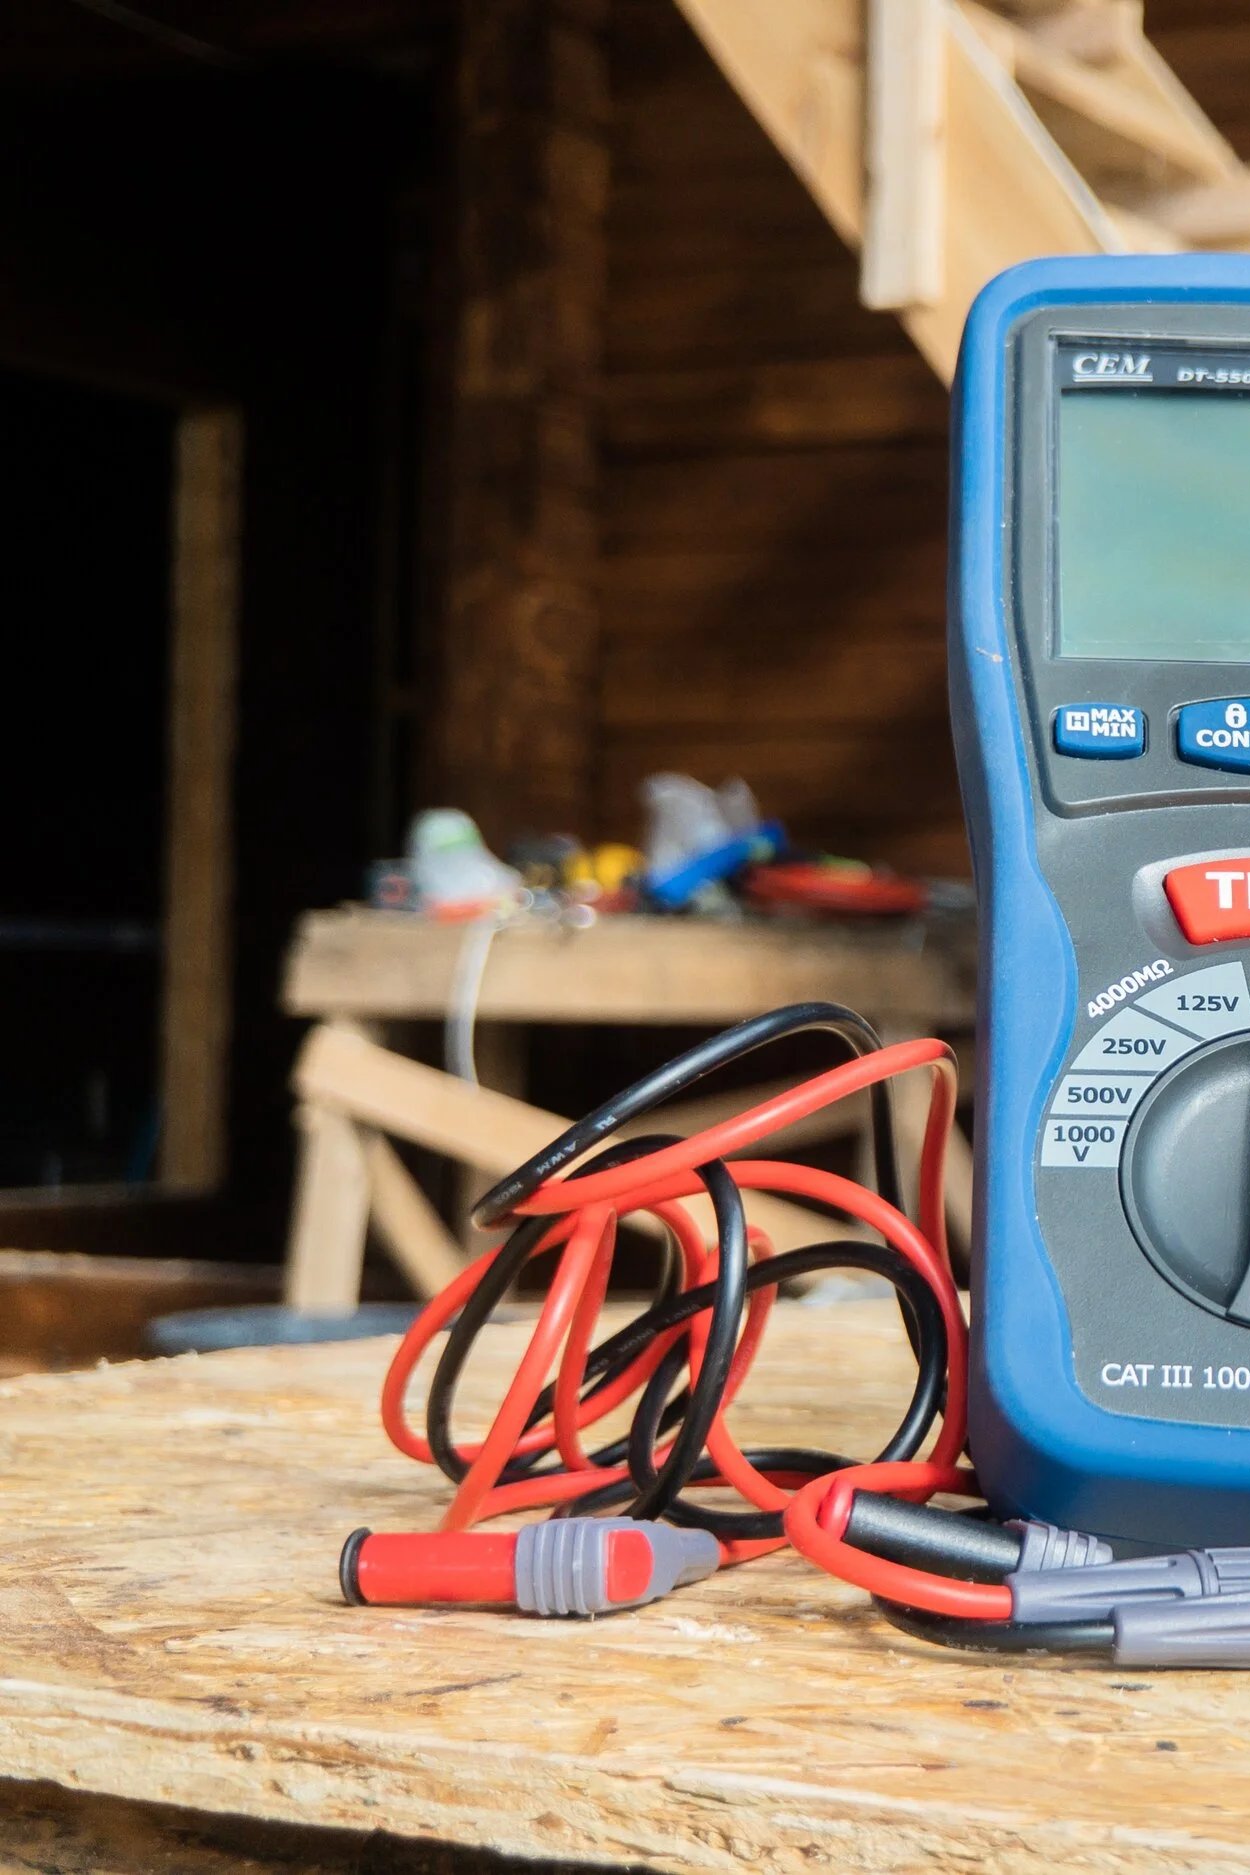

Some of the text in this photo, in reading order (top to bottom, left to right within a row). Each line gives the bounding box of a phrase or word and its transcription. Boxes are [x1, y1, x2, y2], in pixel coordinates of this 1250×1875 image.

[1073, 352, 1150, 376] CEM
[1091, 708, 1136, 723] MAX
[1091, 722, 1136, 738] MIN
[1087, 958, 1175, 1019] 4000MΩ
[1176, 994, 1240, 1013] 125V
[1102, 1037, 1167, 1056] 250V
[1066, 1086, 1132, 1105] 500V
[1053, 1125, 1115, 1144] 1000
[1072, 1145, 1090, 1163] V
[1101, 1362, 1154, 1388] CAT
[1160, 1364, 1193, 1389] III
